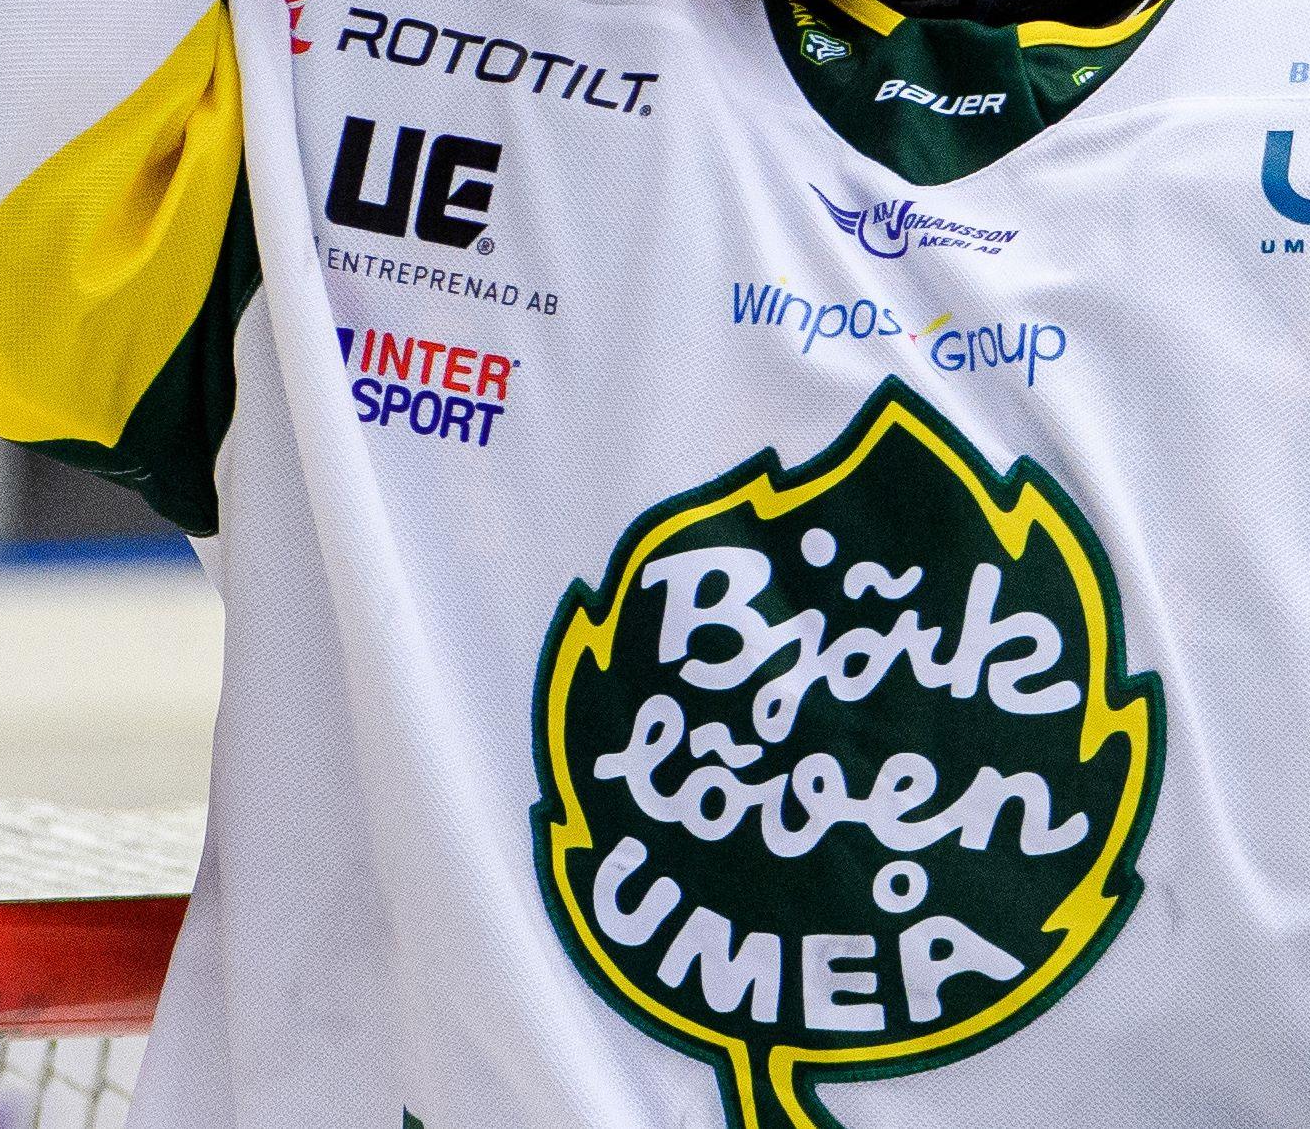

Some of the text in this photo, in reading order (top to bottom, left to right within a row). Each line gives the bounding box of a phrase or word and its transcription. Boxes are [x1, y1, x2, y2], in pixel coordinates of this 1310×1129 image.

[327, 247, 559, 316] ENTREPRENAD AB
[1260, 239, 1305, 255] UM
[360, 328, 512, 401] INTER
[930, 322, 1066, 388] Group
[351, 377, 505, 448] SPORT
[592, 836, 1025, 1033] UMEÅ
